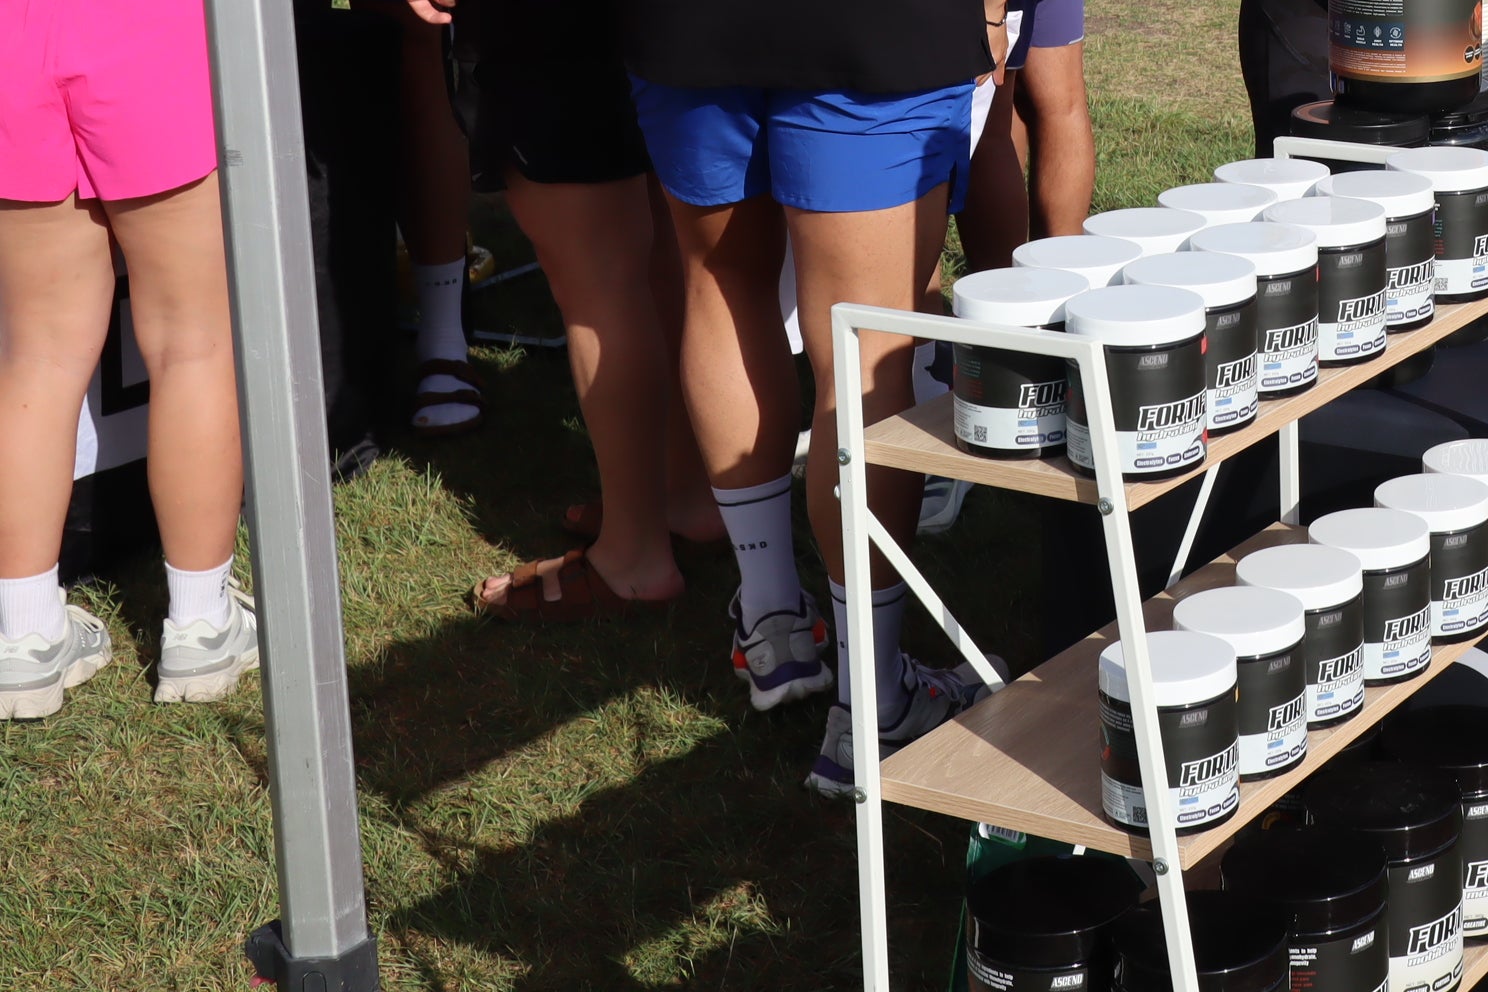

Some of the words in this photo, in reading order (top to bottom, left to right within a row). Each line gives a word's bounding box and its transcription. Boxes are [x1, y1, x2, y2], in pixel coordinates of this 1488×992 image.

[1136, 420, 1199, 441] hydration
[1180, 710, 1208, 725] ASCEND
[1407, 863, 1435, 881] ASCEND
[1351, 930, 1375, 952] ASCEND
[1051, 973, 1084, 989] ASCEND
